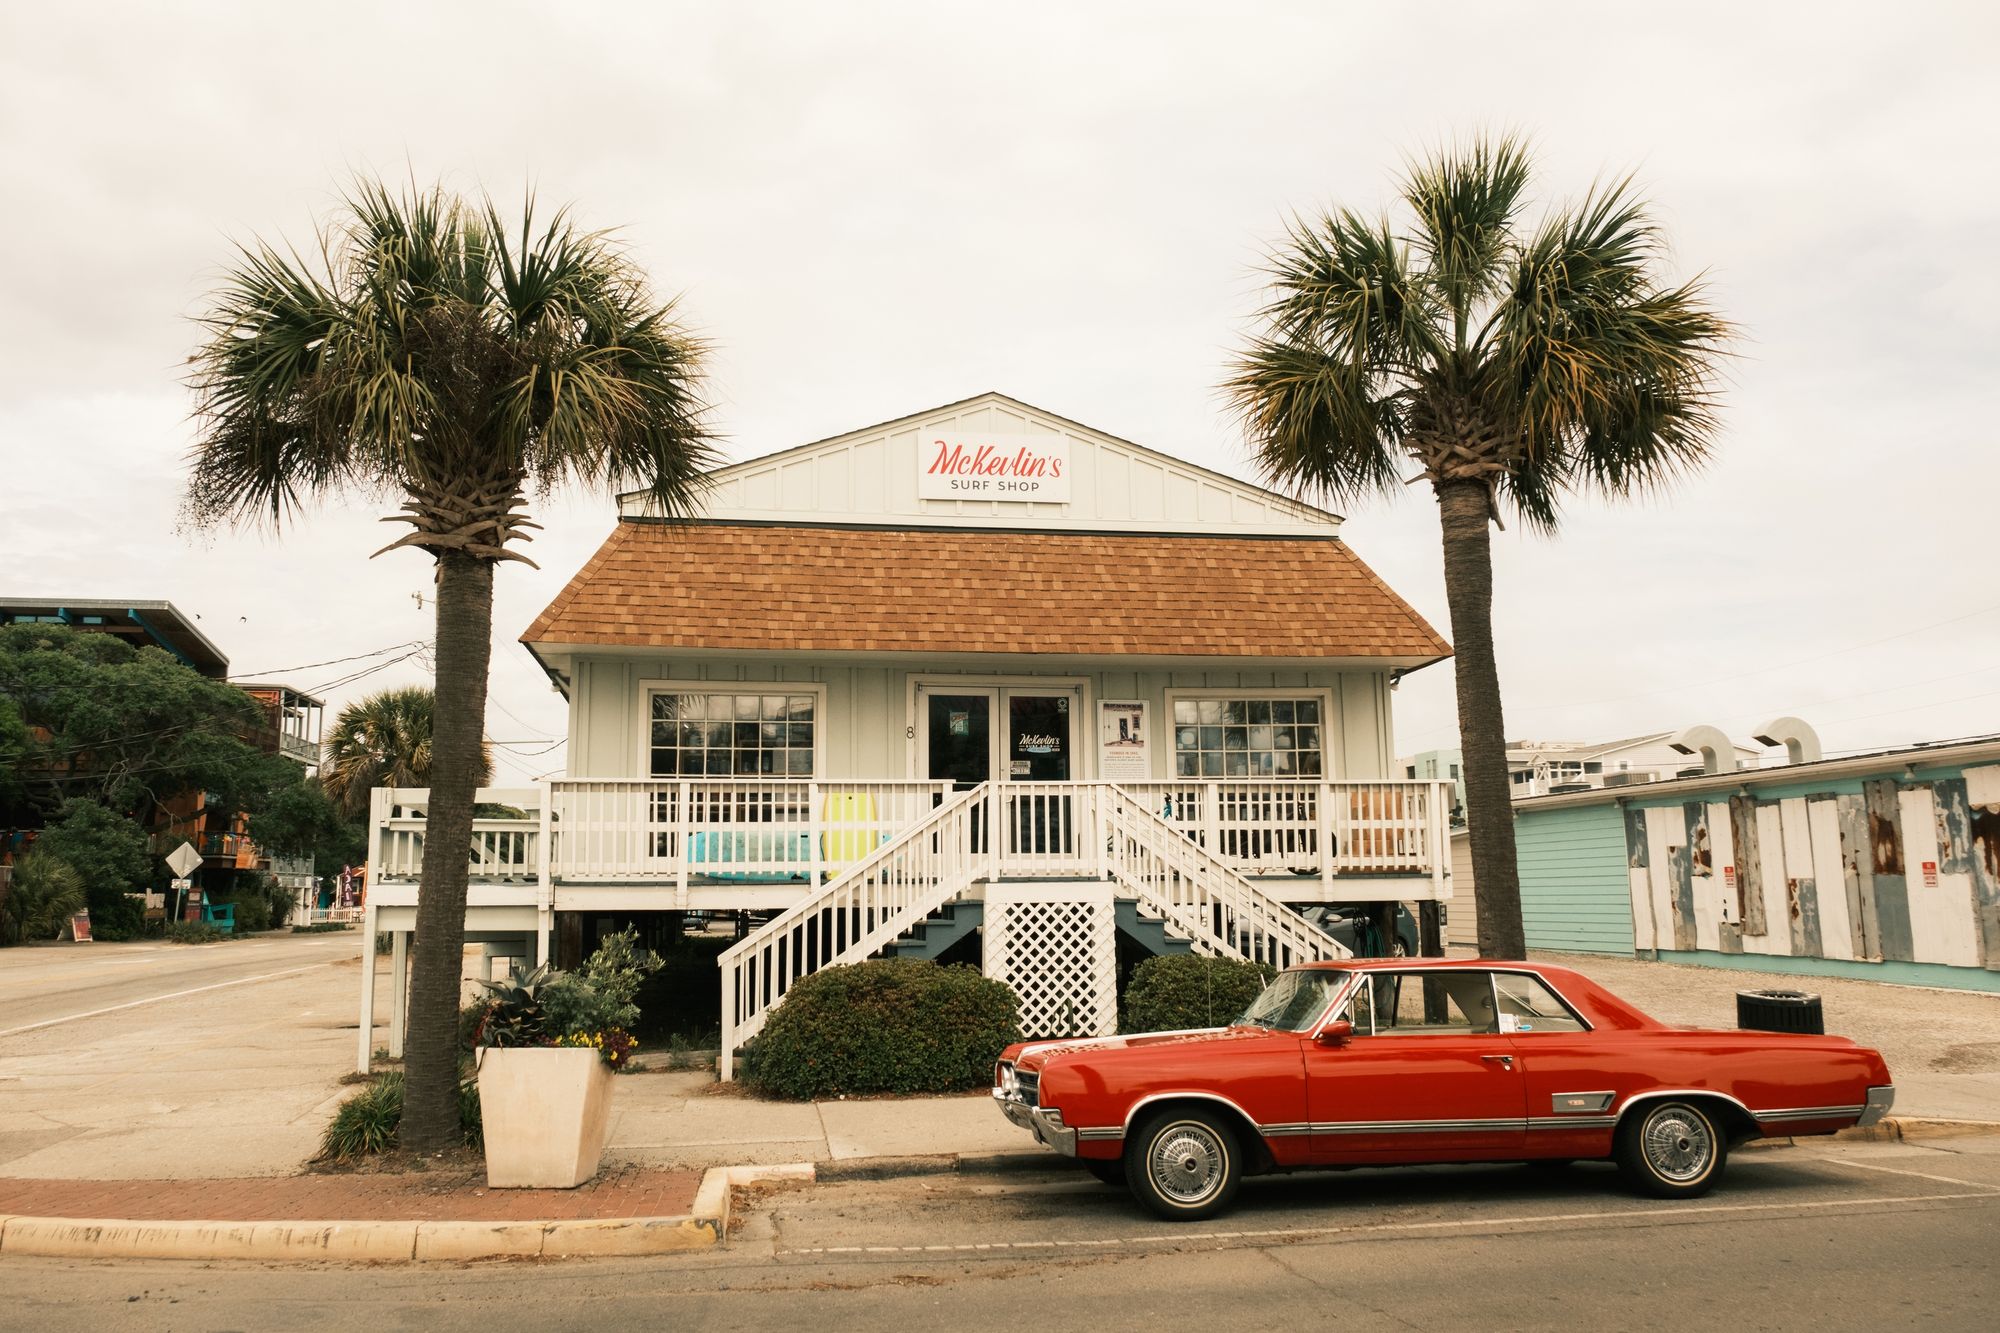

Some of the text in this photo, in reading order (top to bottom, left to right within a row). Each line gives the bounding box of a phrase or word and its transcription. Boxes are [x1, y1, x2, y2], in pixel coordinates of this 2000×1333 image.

[928, 440, 1062, 478] McKevlin's
[951, 479, 1040, 492] SURF SHOP
[906, 726, 914, 739] 8
[1019, 733, 1060, 745] McKevlin's
